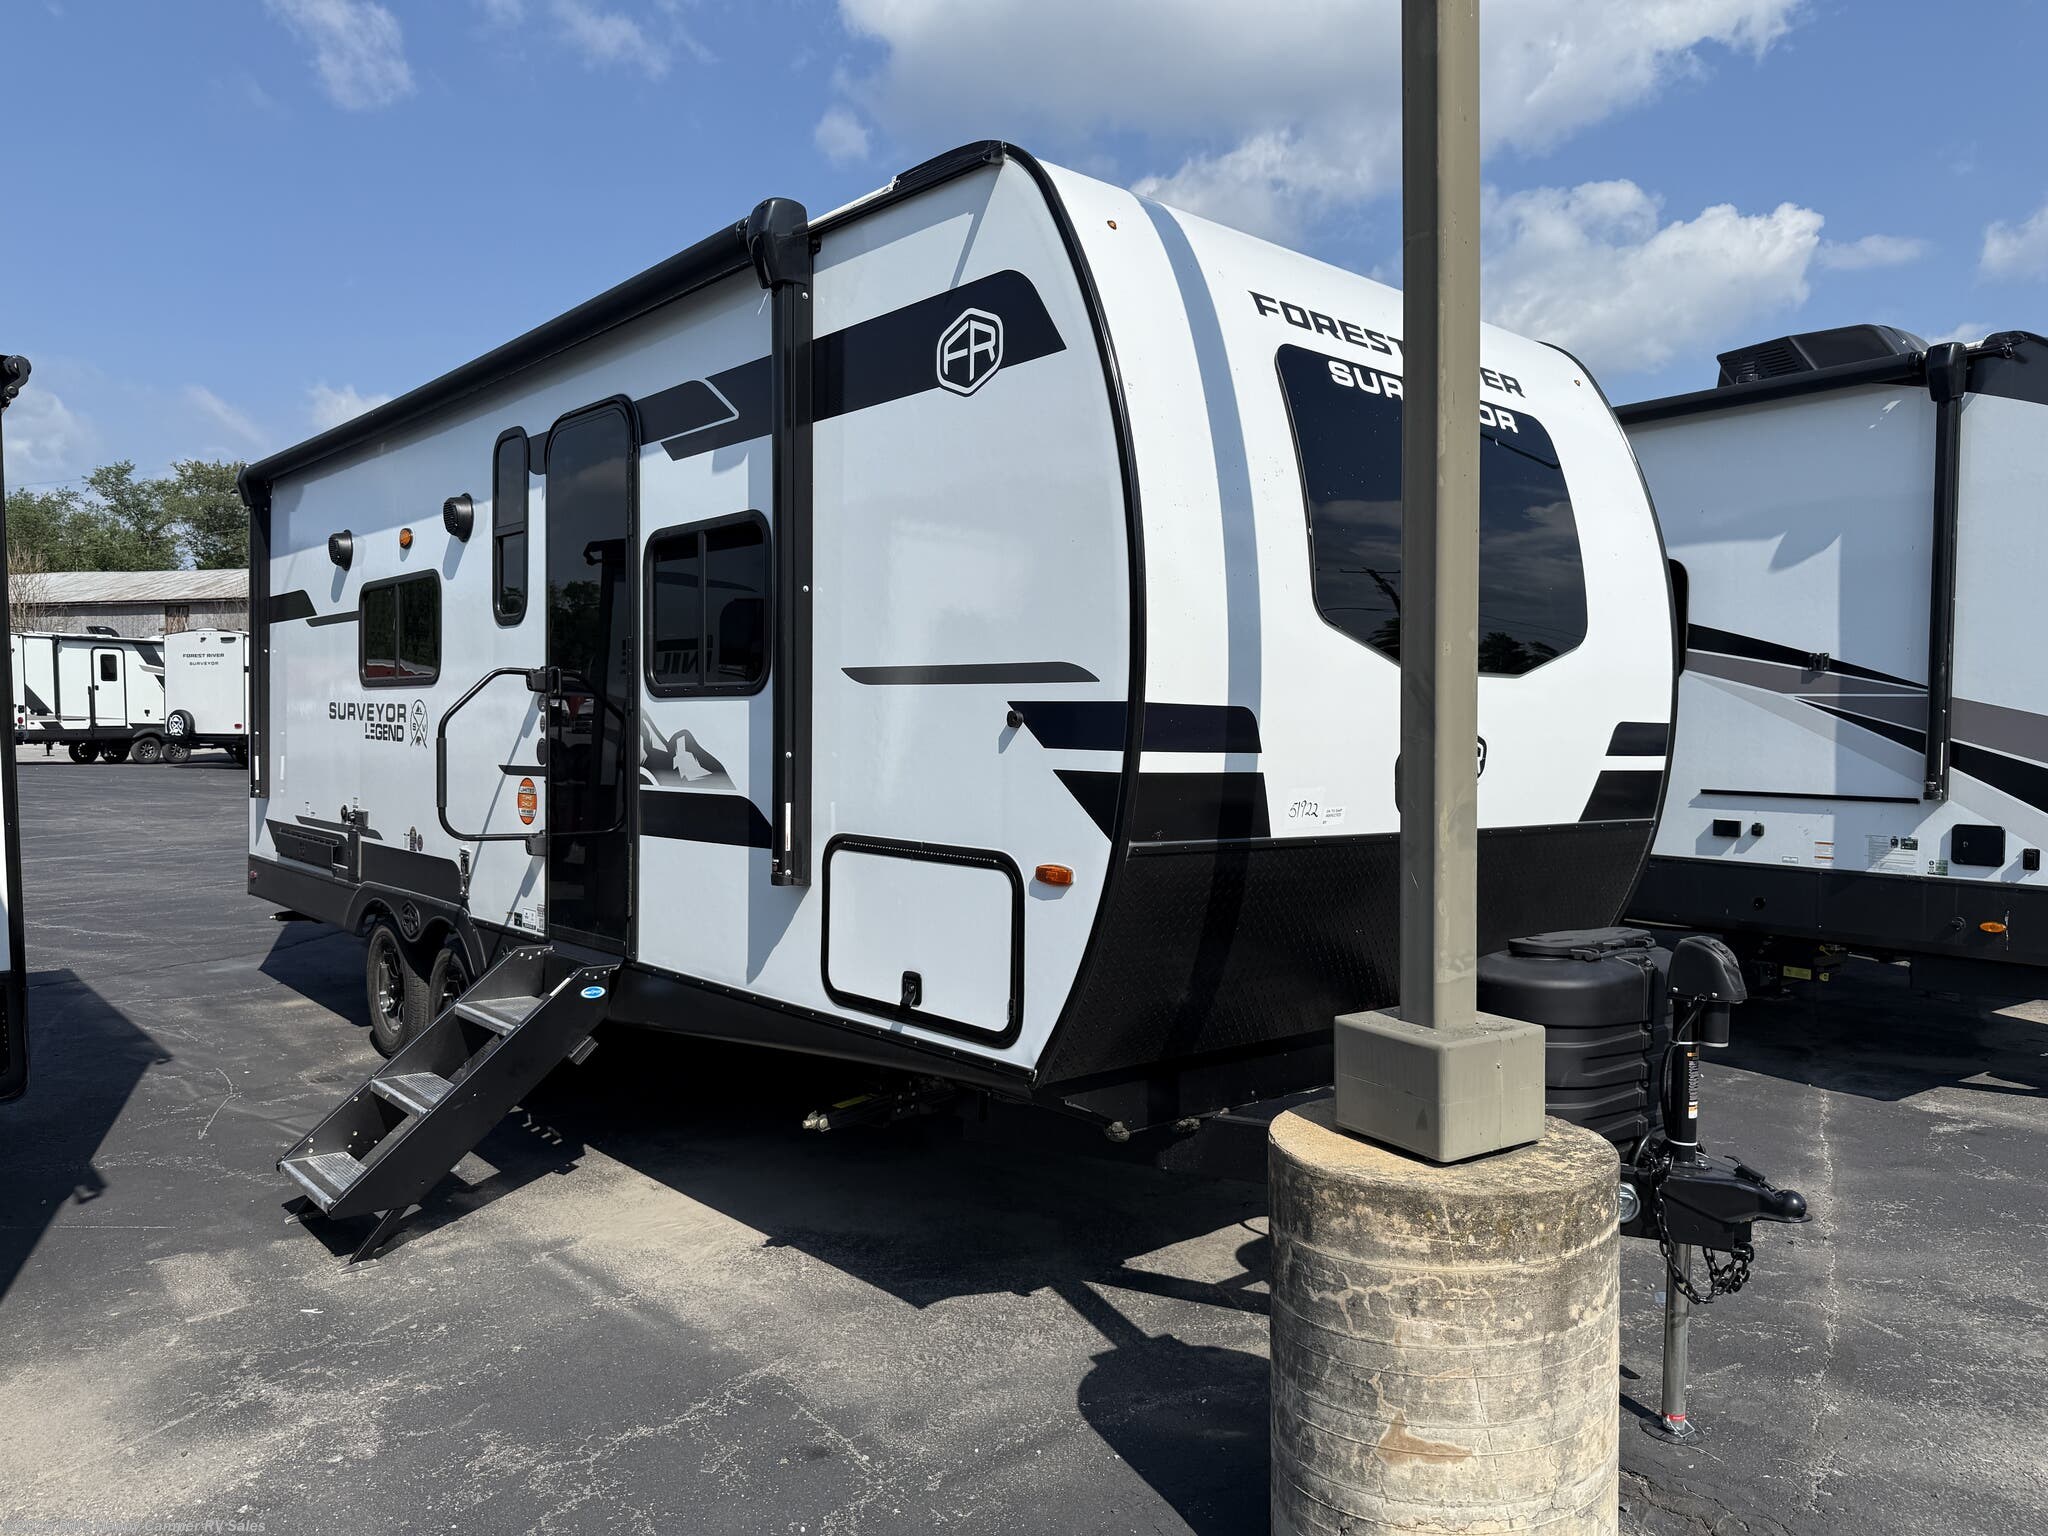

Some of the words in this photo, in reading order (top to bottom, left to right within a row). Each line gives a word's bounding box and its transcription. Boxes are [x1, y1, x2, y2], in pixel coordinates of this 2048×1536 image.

[1328, 360, 1519, 434] SUROR
[328, 701, 407, 723] SURVEYOR
[364, 722, 405, 742] LEGEND
